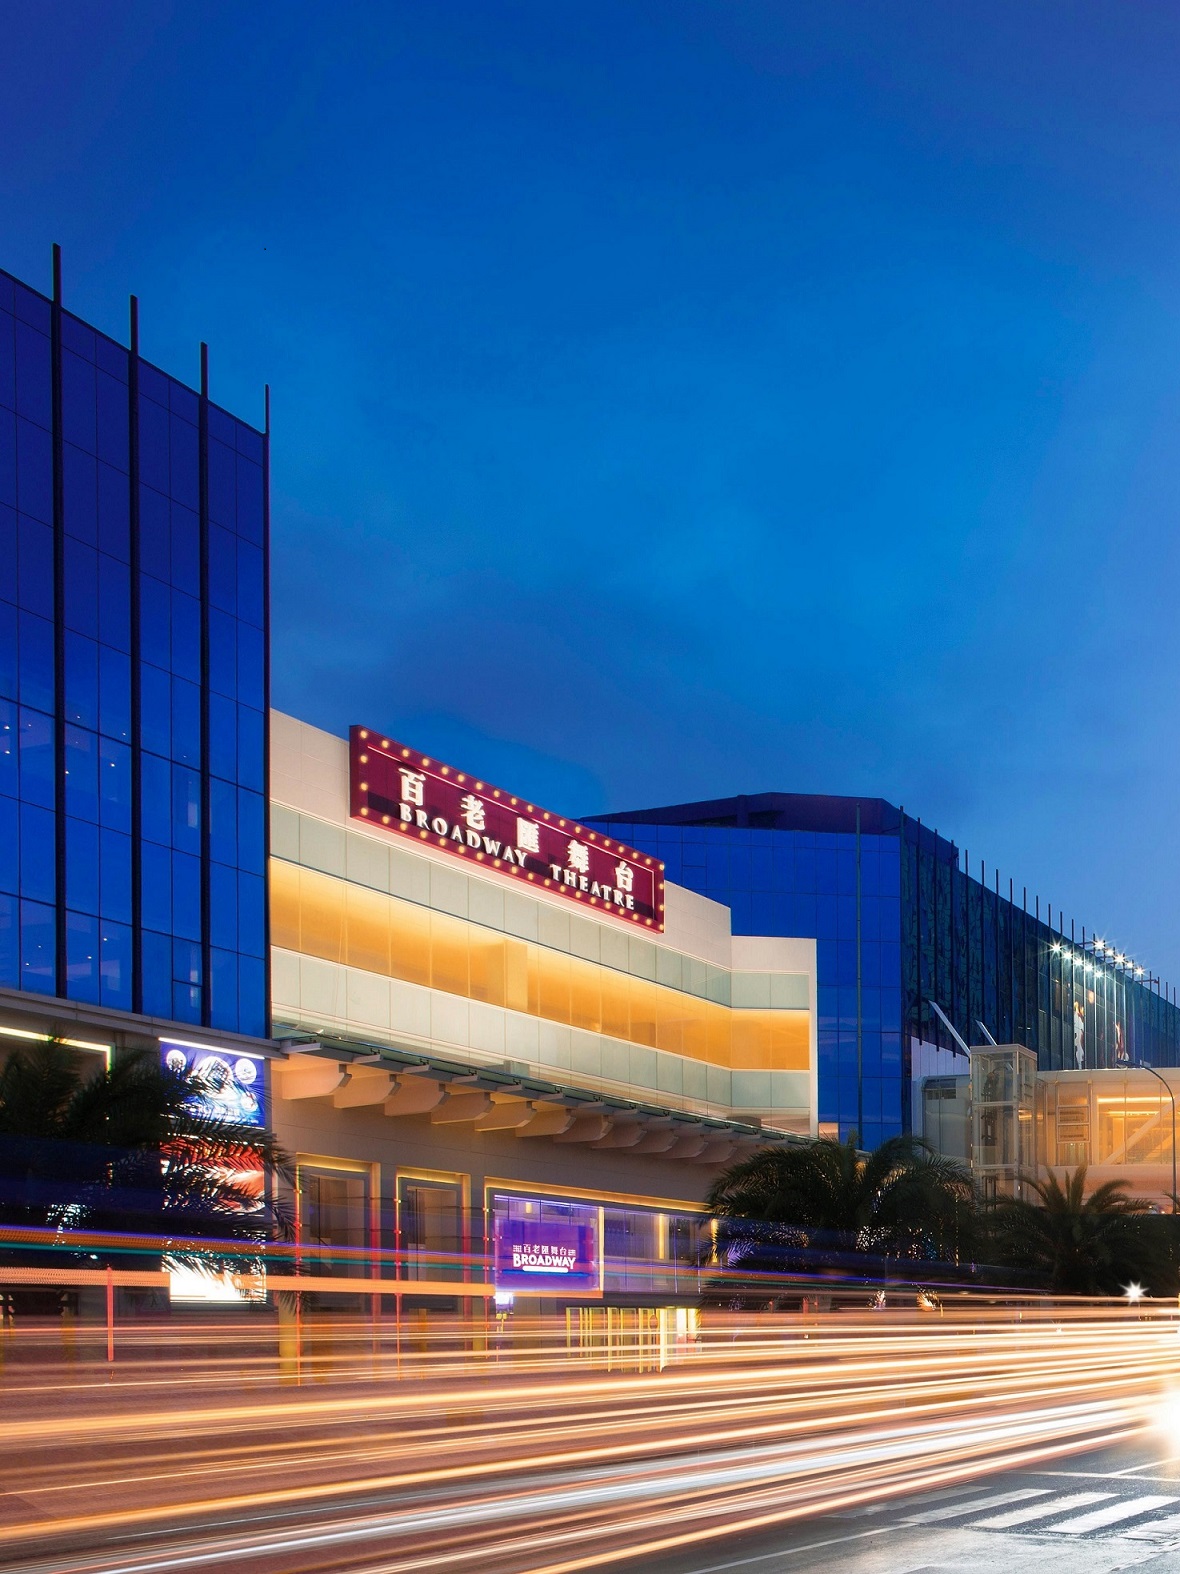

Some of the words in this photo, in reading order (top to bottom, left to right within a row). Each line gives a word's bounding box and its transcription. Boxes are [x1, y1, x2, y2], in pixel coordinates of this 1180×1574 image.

[398, 803, 528, 868] BROADWAY
[548, 863, 635, 911] THEATRE
[513, 1253, 576, 1269] BROADWAY
